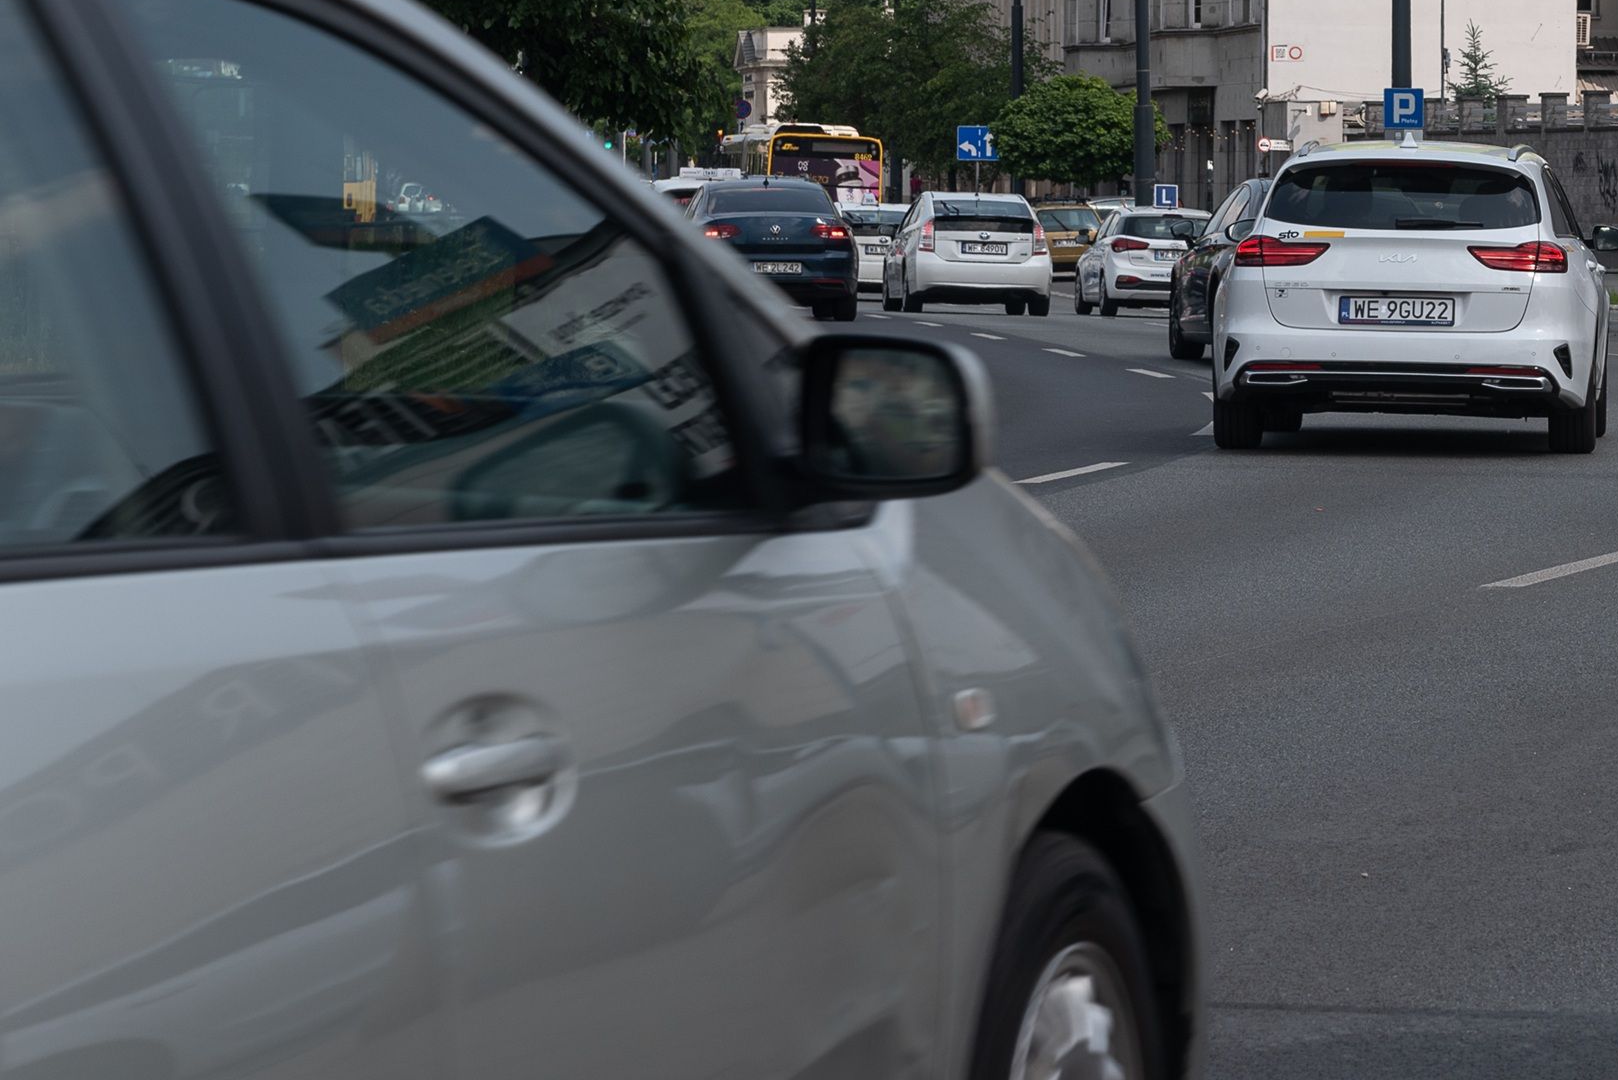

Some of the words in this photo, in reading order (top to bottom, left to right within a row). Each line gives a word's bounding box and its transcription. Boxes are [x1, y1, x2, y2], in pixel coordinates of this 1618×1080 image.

[1162, 189, 1172, 204] L
[1278, 229, 1299, 240] sto
[1354, 301, 1379, 319] WE
[1387, 301, 1448, 320] 9GU22
